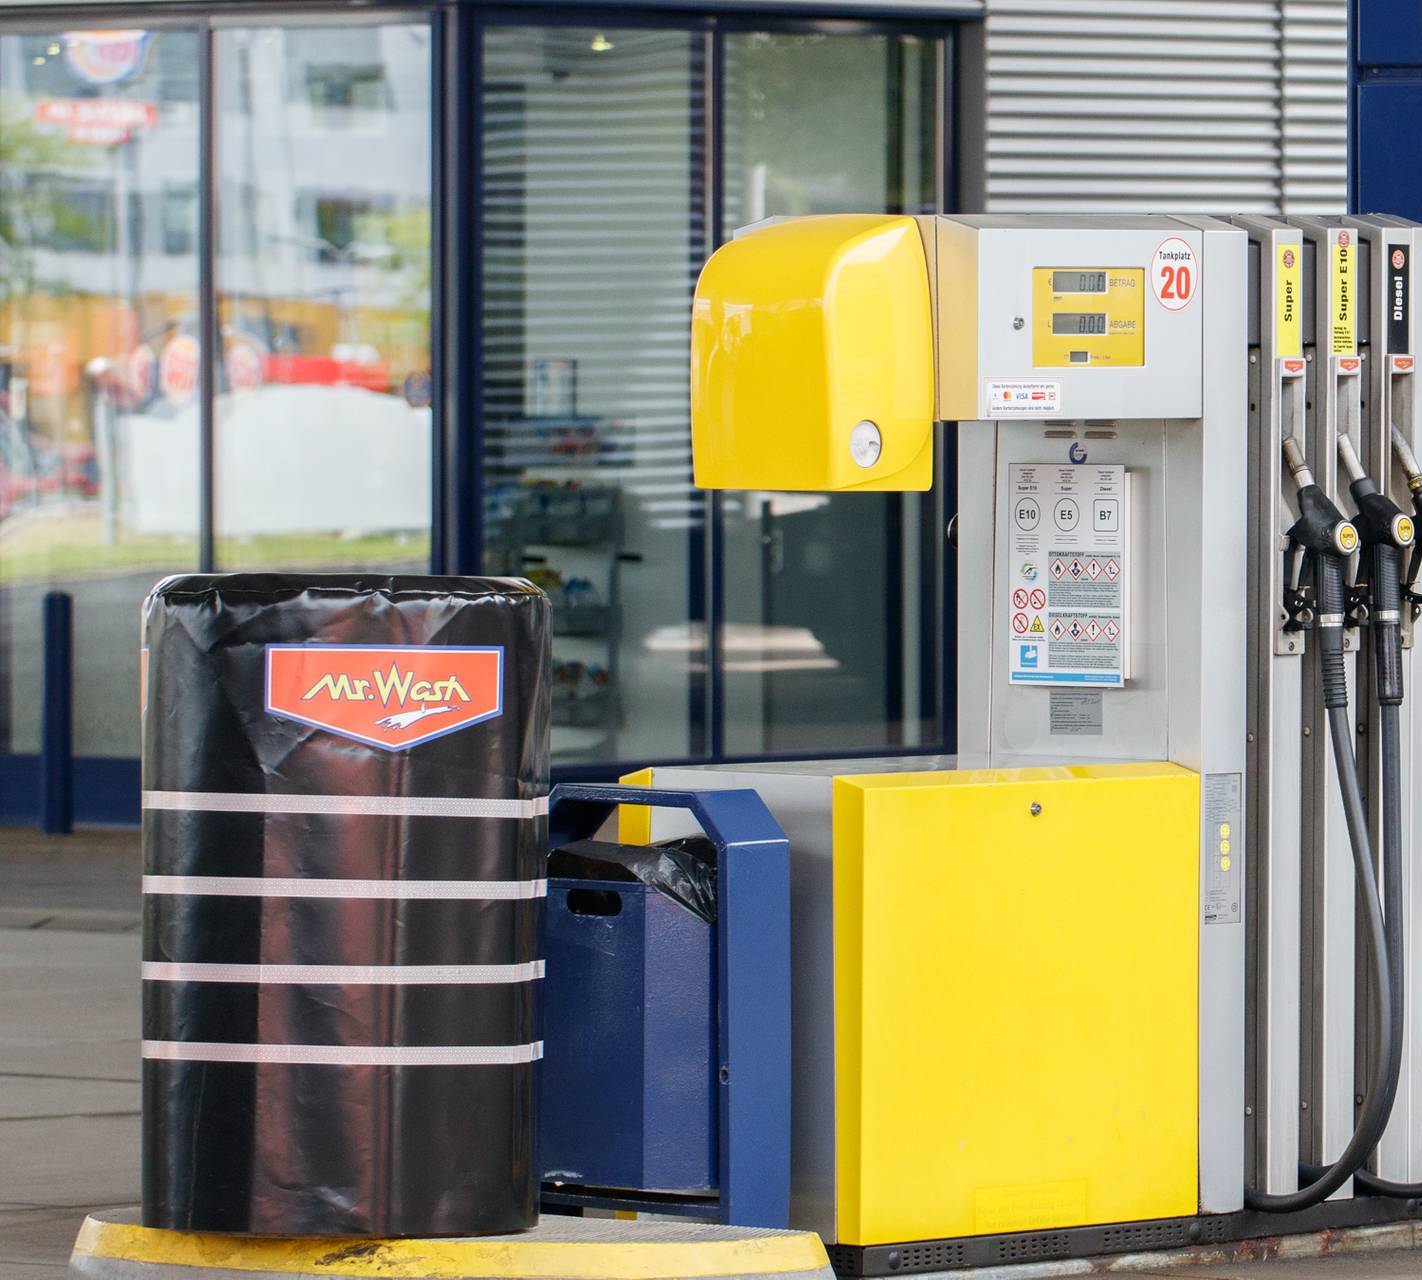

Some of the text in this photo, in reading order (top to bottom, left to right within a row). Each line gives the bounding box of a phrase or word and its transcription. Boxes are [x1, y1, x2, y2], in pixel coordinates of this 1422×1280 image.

[1159, 251, 1191, 261] Tankplatz
[1340, 249, 1348, 274] E10
[1109, 278, 1136, 288] BETRAG
[1160, 266, 1191, 300] 20
[1284, 279, 1293, 322] Super
[1339, 279, 1348, 321] Super
[1393, 276, 1403, 321] Diesel
[1109, 320, 1136, 329] ABGABE
[1016, 392, 1029, 400] VISA
[1019, 509, 1036, 520] E10
[1060, 509, 1073, 520] E5
[1099, 510, 1112, 521] B7
